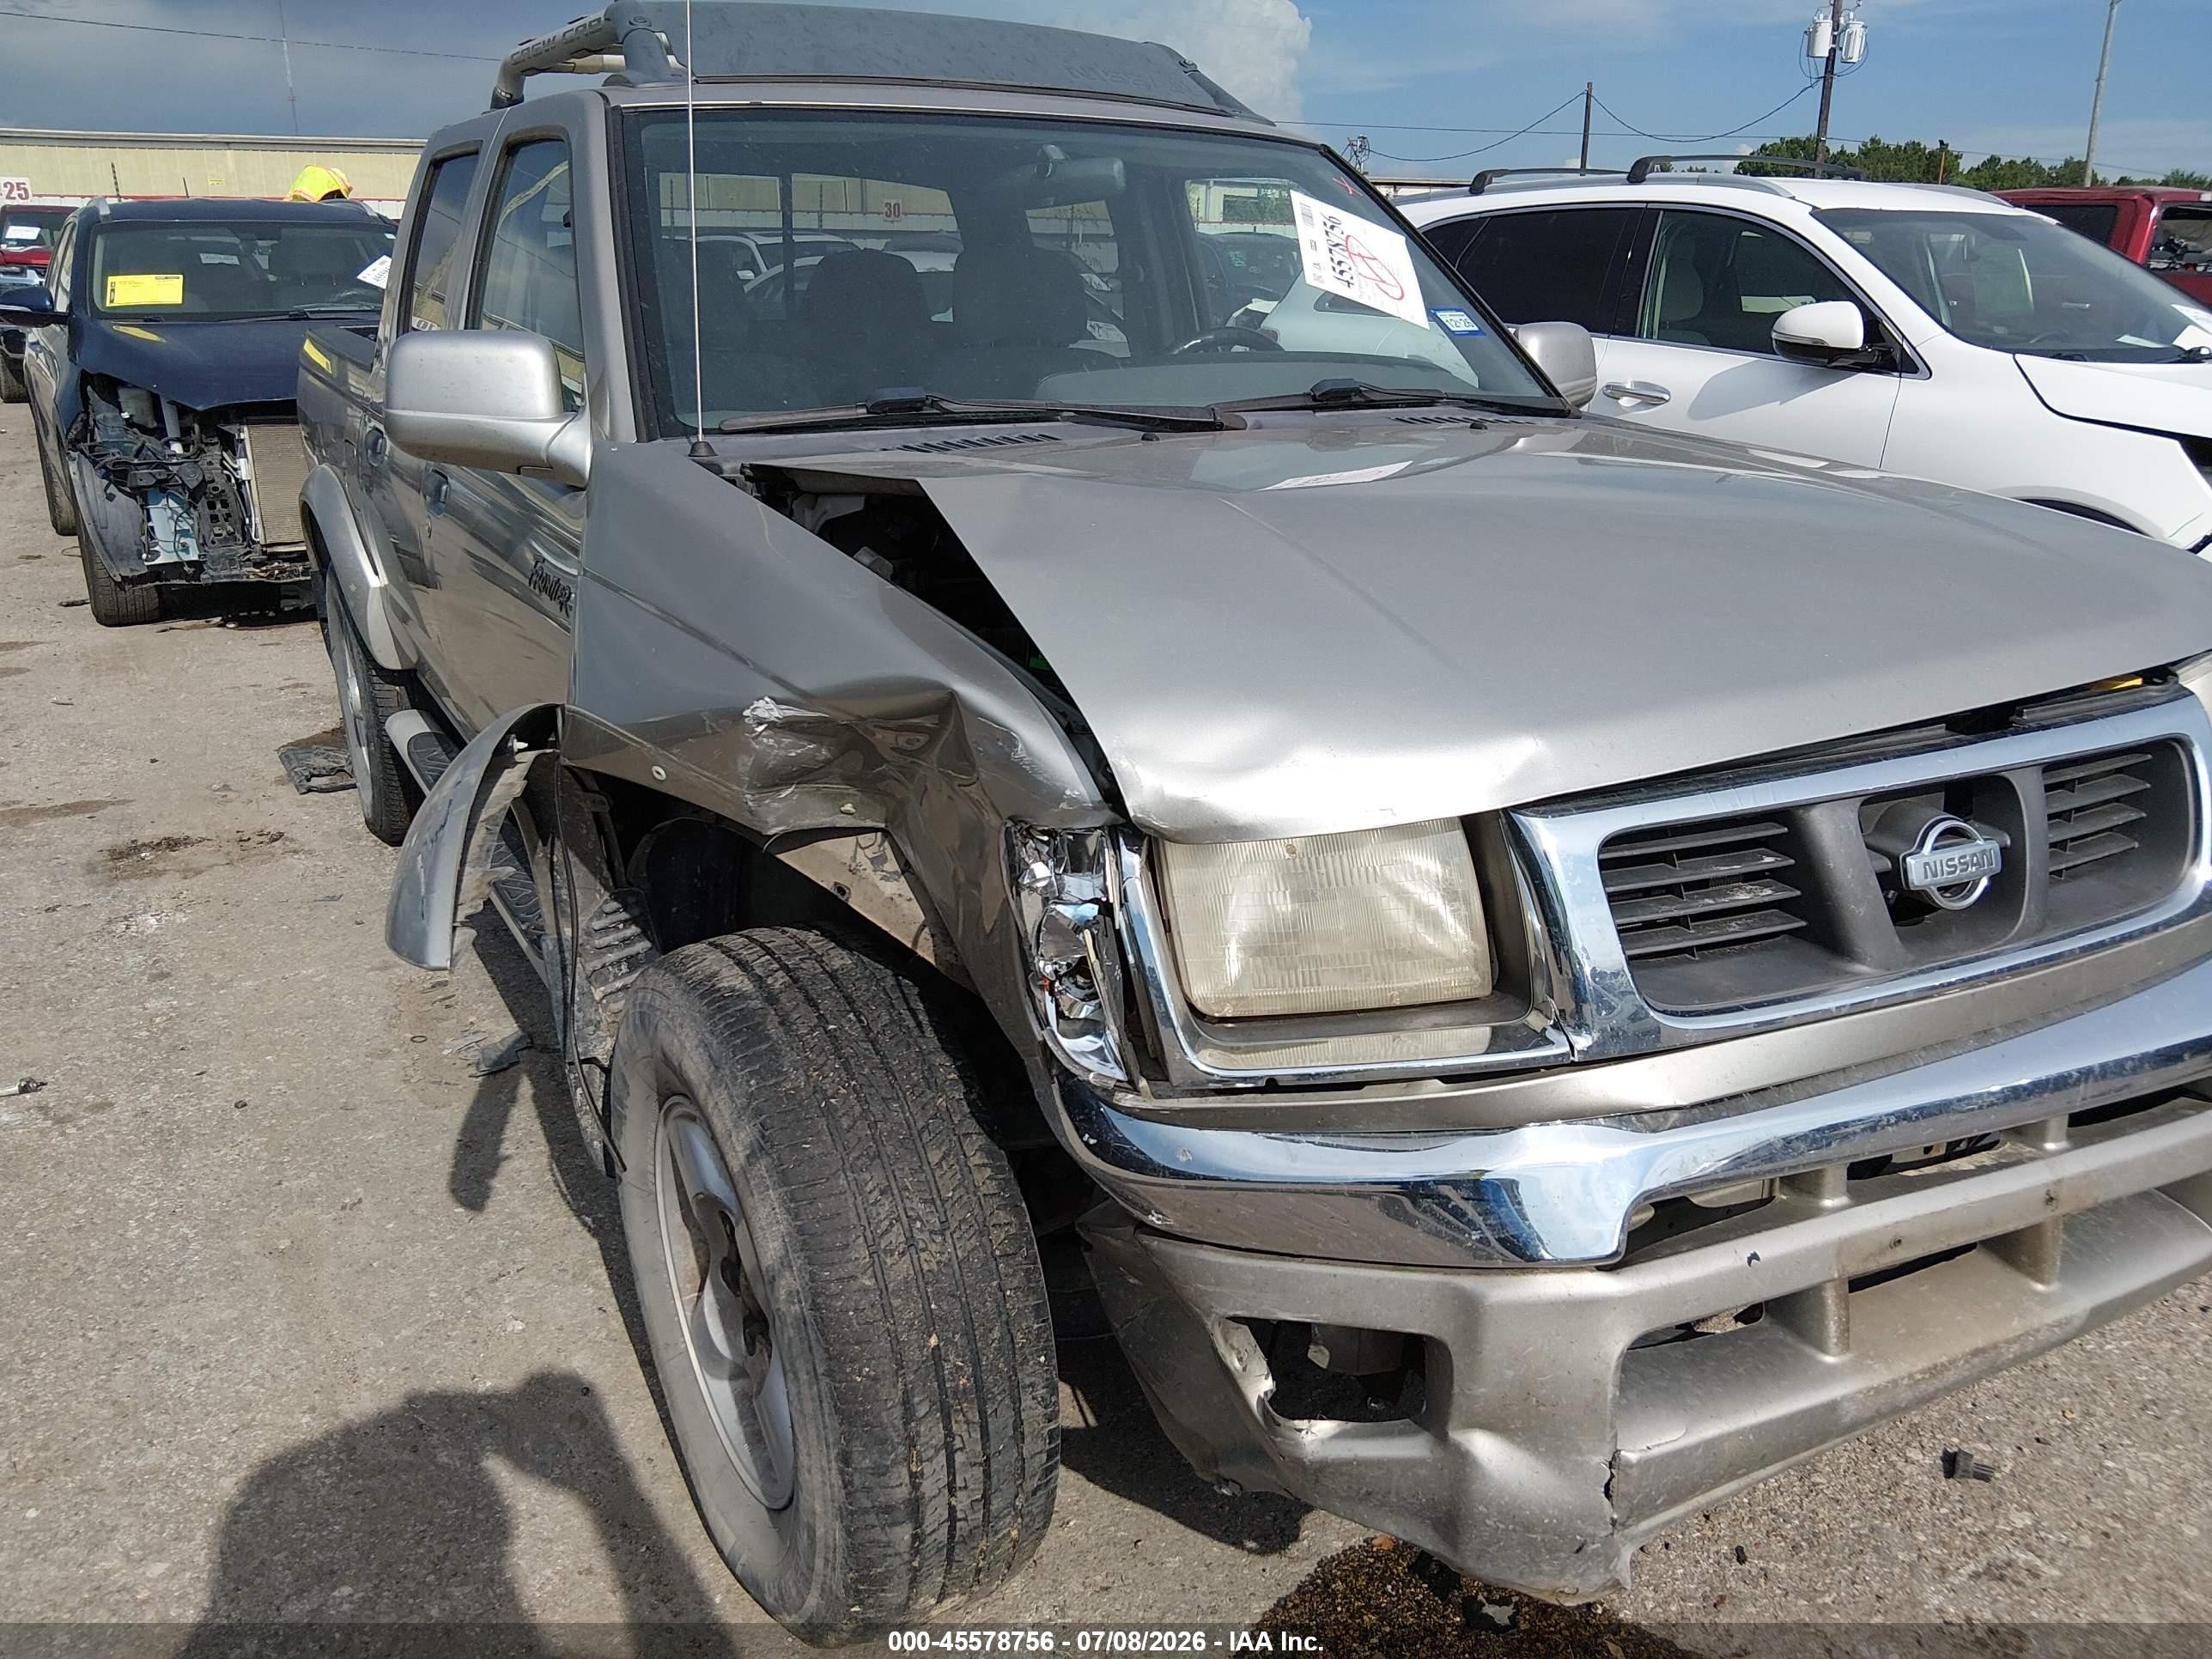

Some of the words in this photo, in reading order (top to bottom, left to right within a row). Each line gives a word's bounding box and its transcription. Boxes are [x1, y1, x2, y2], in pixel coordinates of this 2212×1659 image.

[511, 35, 557, 65] CREW
[562, 16, 602, 44] CAB
[0, 181, 30, 201] 25
[884, 202, 901, 218] 30
[1320, 211, 1354, 289] 45578756
[1923, 848, 1995, 879] NISSAN
